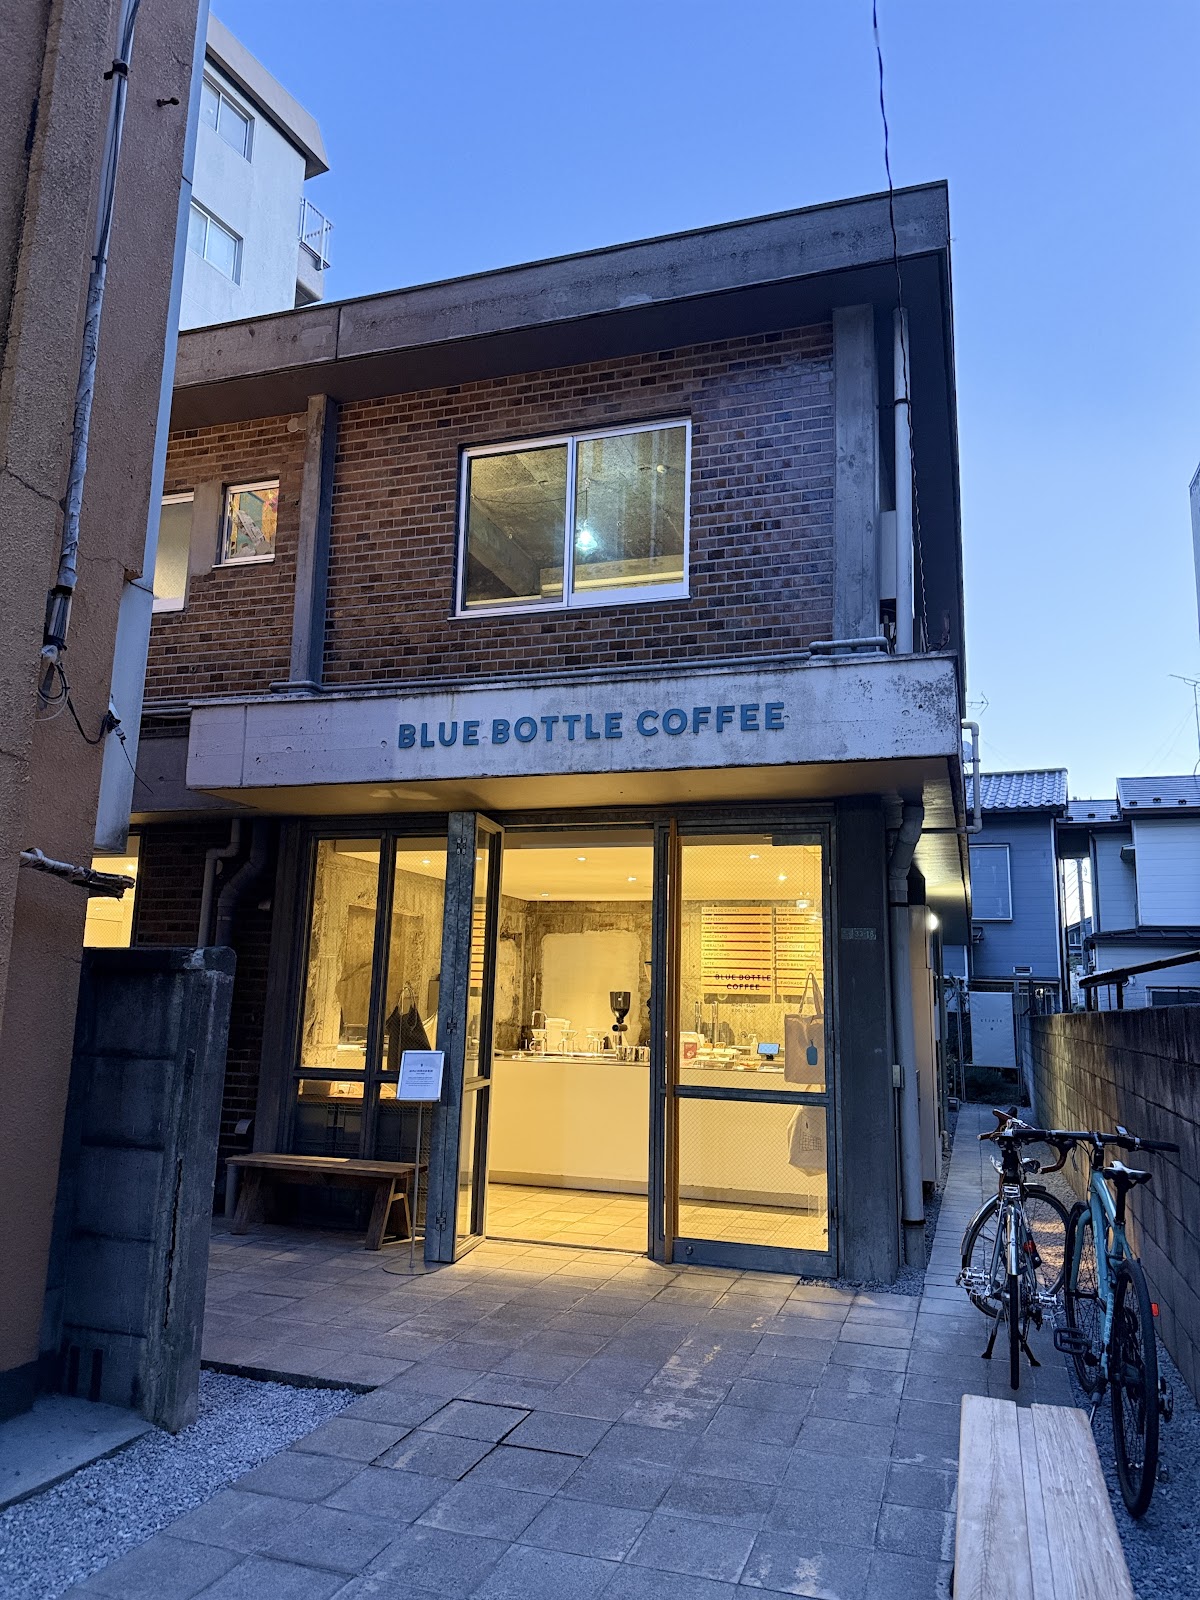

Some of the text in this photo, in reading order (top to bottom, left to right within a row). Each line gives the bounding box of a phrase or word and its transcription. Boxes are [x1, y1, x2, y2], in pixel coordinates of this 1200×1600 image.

[398, 702, 785, 748] BLUE BOTTLE COFFEE
